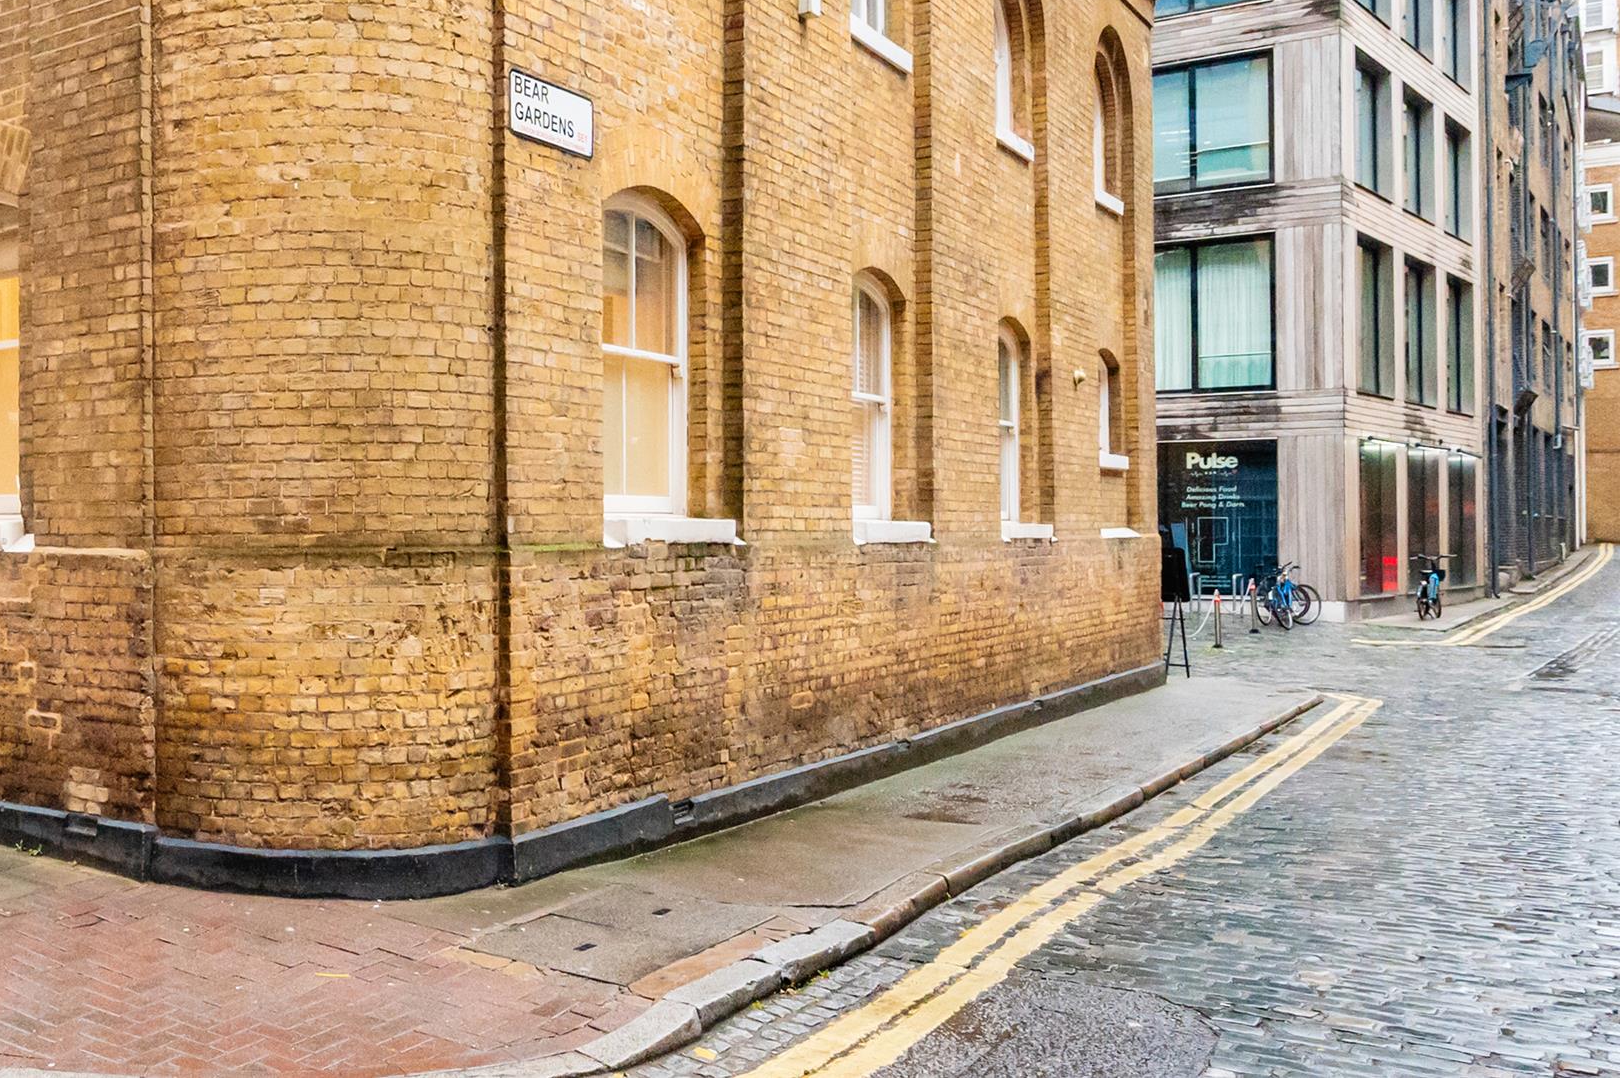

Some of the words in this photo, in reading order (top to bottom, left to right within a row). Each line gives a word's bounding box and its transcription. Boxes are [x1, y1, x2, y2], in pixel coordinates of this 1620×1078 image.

[514, 75, 549, 104] BEAR
[514, 101, 575, 139] GARDENS
[1185, 452, 1239, 469] Pulse
[1185, 494, 1217, 502] Amazing
[1199, 501, 1217, 509] Pong
